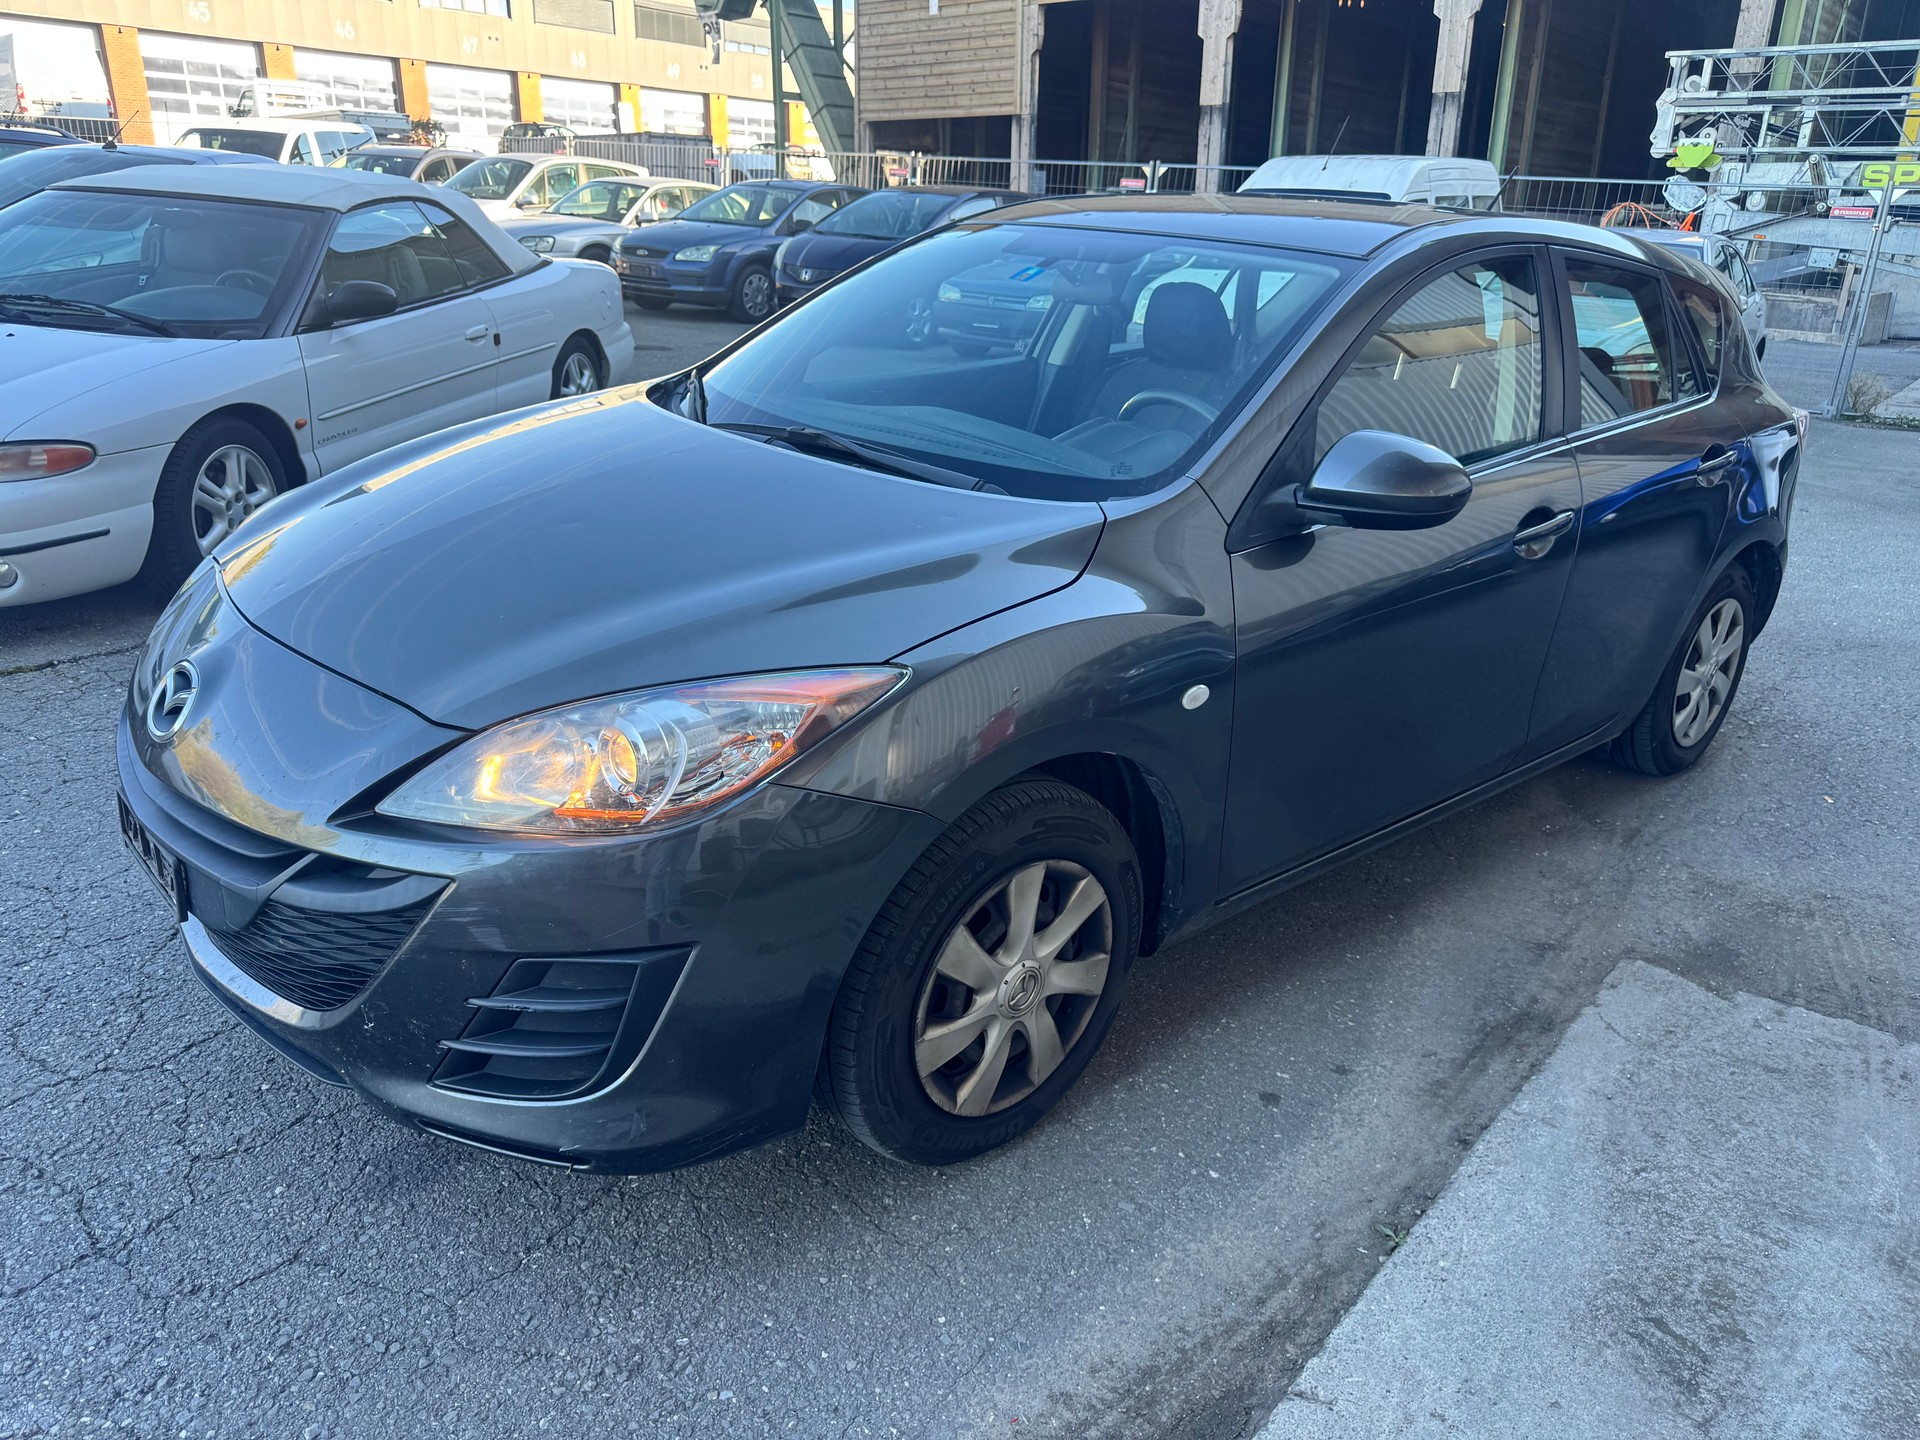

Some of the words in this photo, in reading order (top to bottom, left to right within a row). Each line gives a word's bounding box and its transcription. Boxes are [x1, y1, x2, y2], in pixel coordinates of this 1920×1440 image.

[188, 0, 211, 23] 45
[335, 19, 355, 40] 46
[463, 35, 478, 55] 47
[571, 50, 587, 69] 48
[666, 63, 680, 80] 49
[751, 73, 764, 90] 50
[904, 871, 972, 966] BRAVURIS
[975, 858, 985, 872] 6
